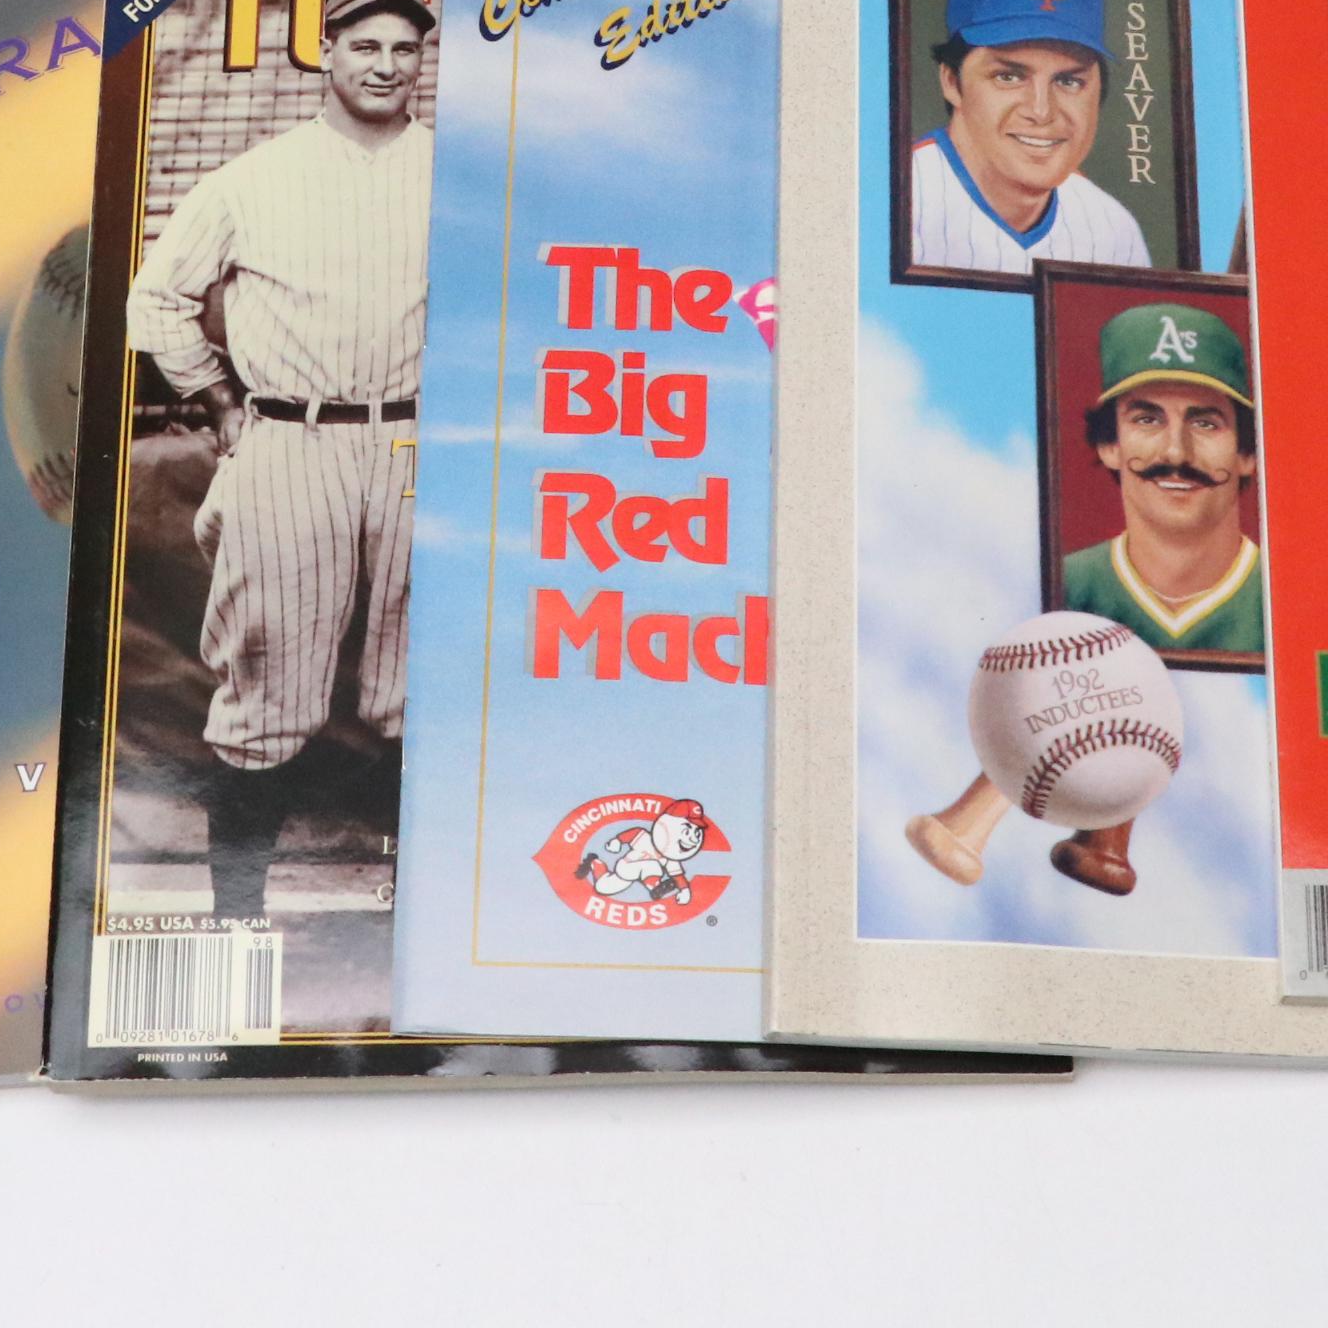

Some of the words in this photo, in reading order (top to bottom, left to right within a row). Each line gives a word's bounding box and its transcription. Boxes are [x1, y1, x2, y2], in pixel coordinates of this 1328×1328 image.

[1126, 2, 1156, 184] SEAVER
[537, 242, 733, 333] The
[535, 347, 708, 459] Big
[532, 470, 728, 573] Red
[1050, 667, 1105, 702] 1992
[1024, 686, 1144, 736] INDUCTEES
[563, 797, 662, 844] CINCINNATI
[107, 916, 154, 932] $4.95
[159, 916, 194, 930] USA
[242, 916, 270, 930] CAN
[584, 897, 669, 927] REDS
[138, 1053, 185, 1063] PRINTED
[188, 1053, 197, 1062] IN
[200, 1052, 228, 1062] USA
